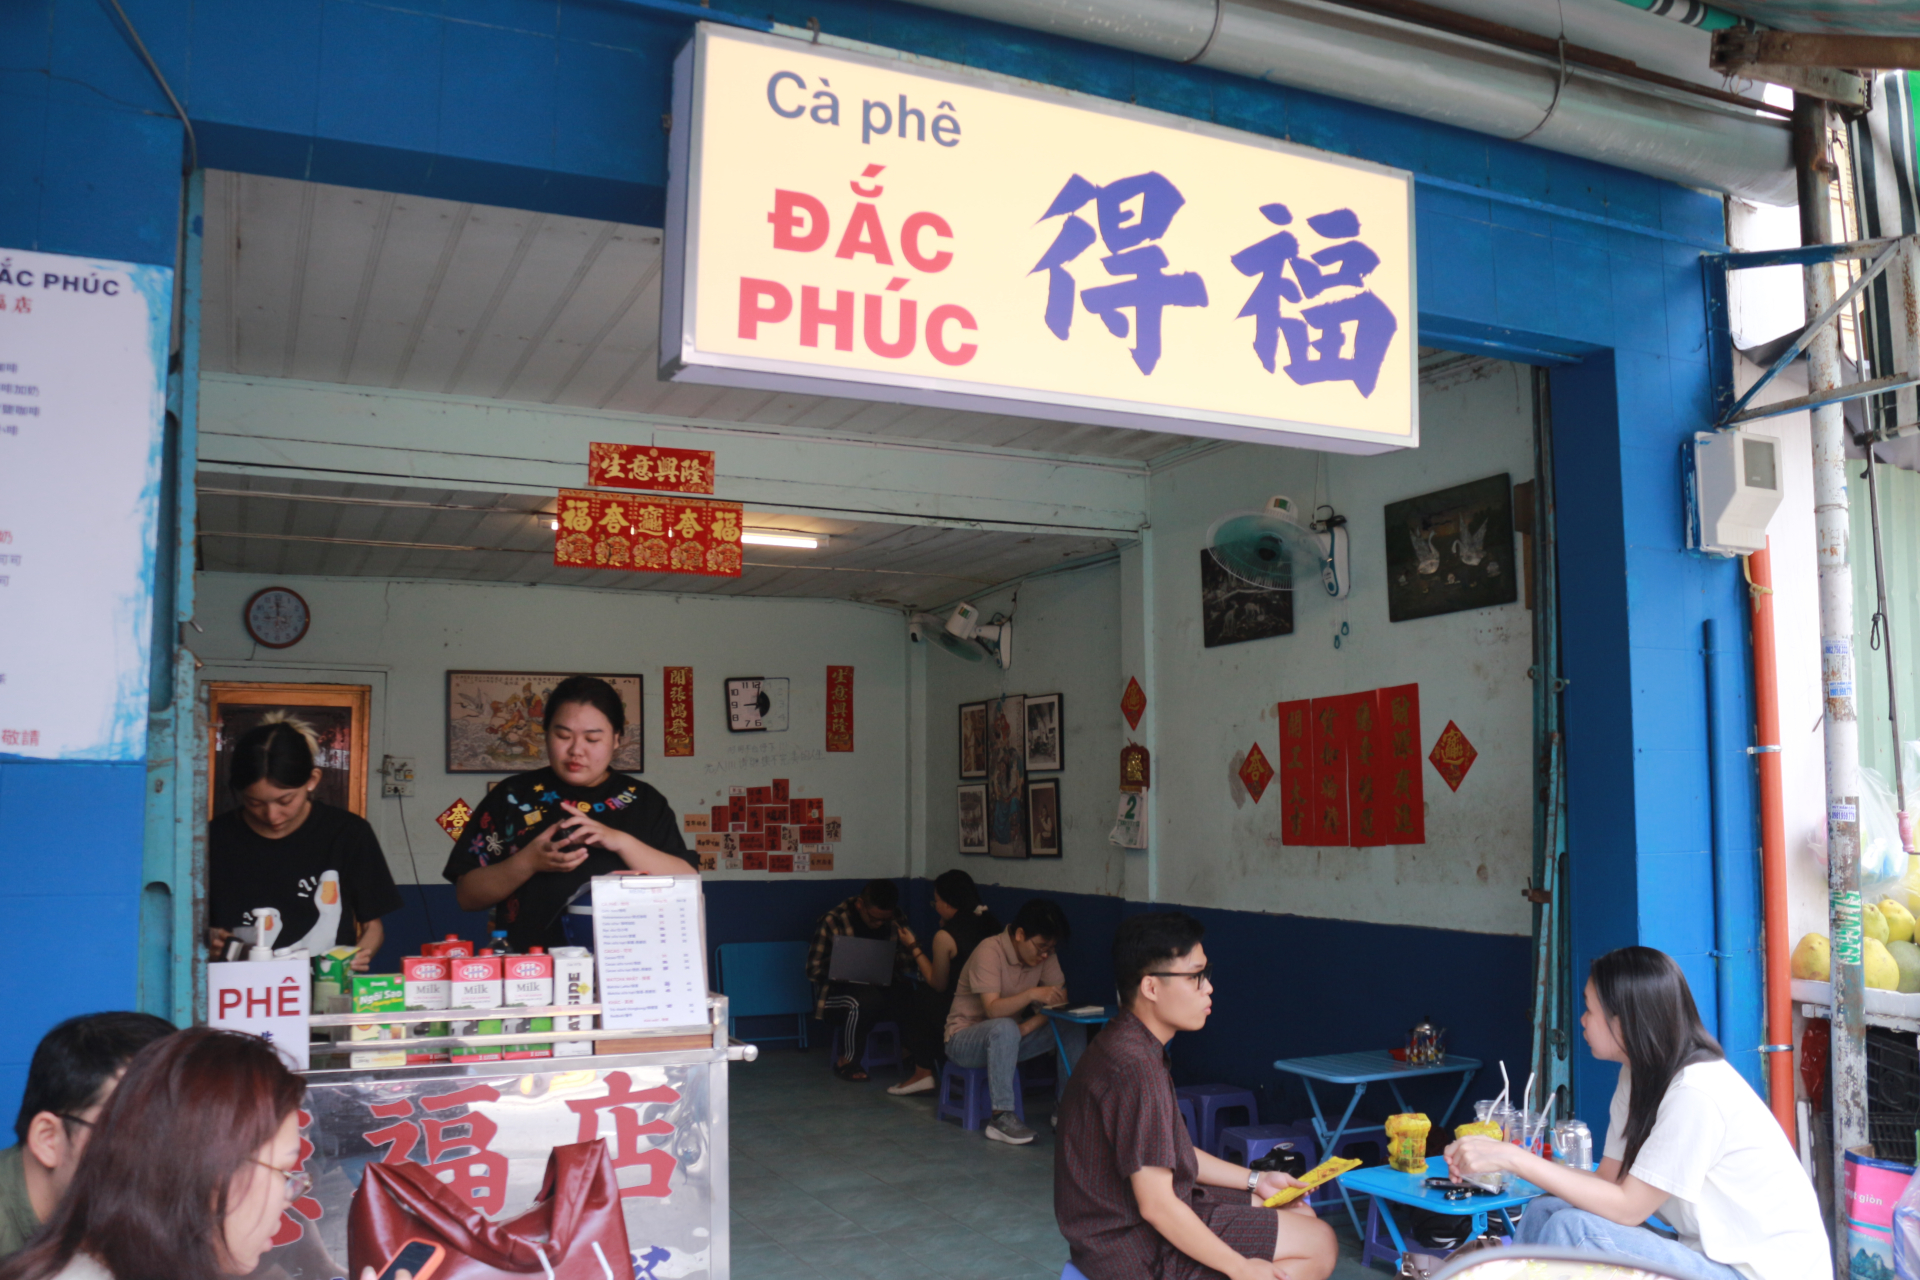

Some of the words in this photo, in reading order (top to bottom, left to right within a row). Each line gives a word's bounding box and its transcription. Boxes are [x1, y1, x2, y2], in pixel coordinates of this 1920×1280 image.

[766, 70, 841, 127] Cà
[861, 93, 962, 148] phê
[766, 163, 955, 274] ĐẮC
[43, 272, 120, 296] PHÚC
[1026, 170, 1398, 400] 得福
[737, 277, 980, 367] PHÚC
[600, 452, 706, 485] 生意興隆
[742, 681, 749, 689] 11
[752, 680, 761, 689] 12
[730, 688, 739, 697] 10
[669, 668, 690, 737] 開張鴻發
[731, 701, 739, 710] 9
[830, 668, 849, 734] 生意興隆
[732, 714, 739, 722] 8
[755, 719, 762, 727] 6
[1124, 795, 1137, 820] 2
[416, 984, 441, 994] Milk
[463, 983, 489, 995] Milk
[516, 981, 540, 993] Milk
[219, 975, 301, 1020] PHÊ
[384, 989, 404, 999] Sao
[1859, 1194, 1883, 1206] giòn
